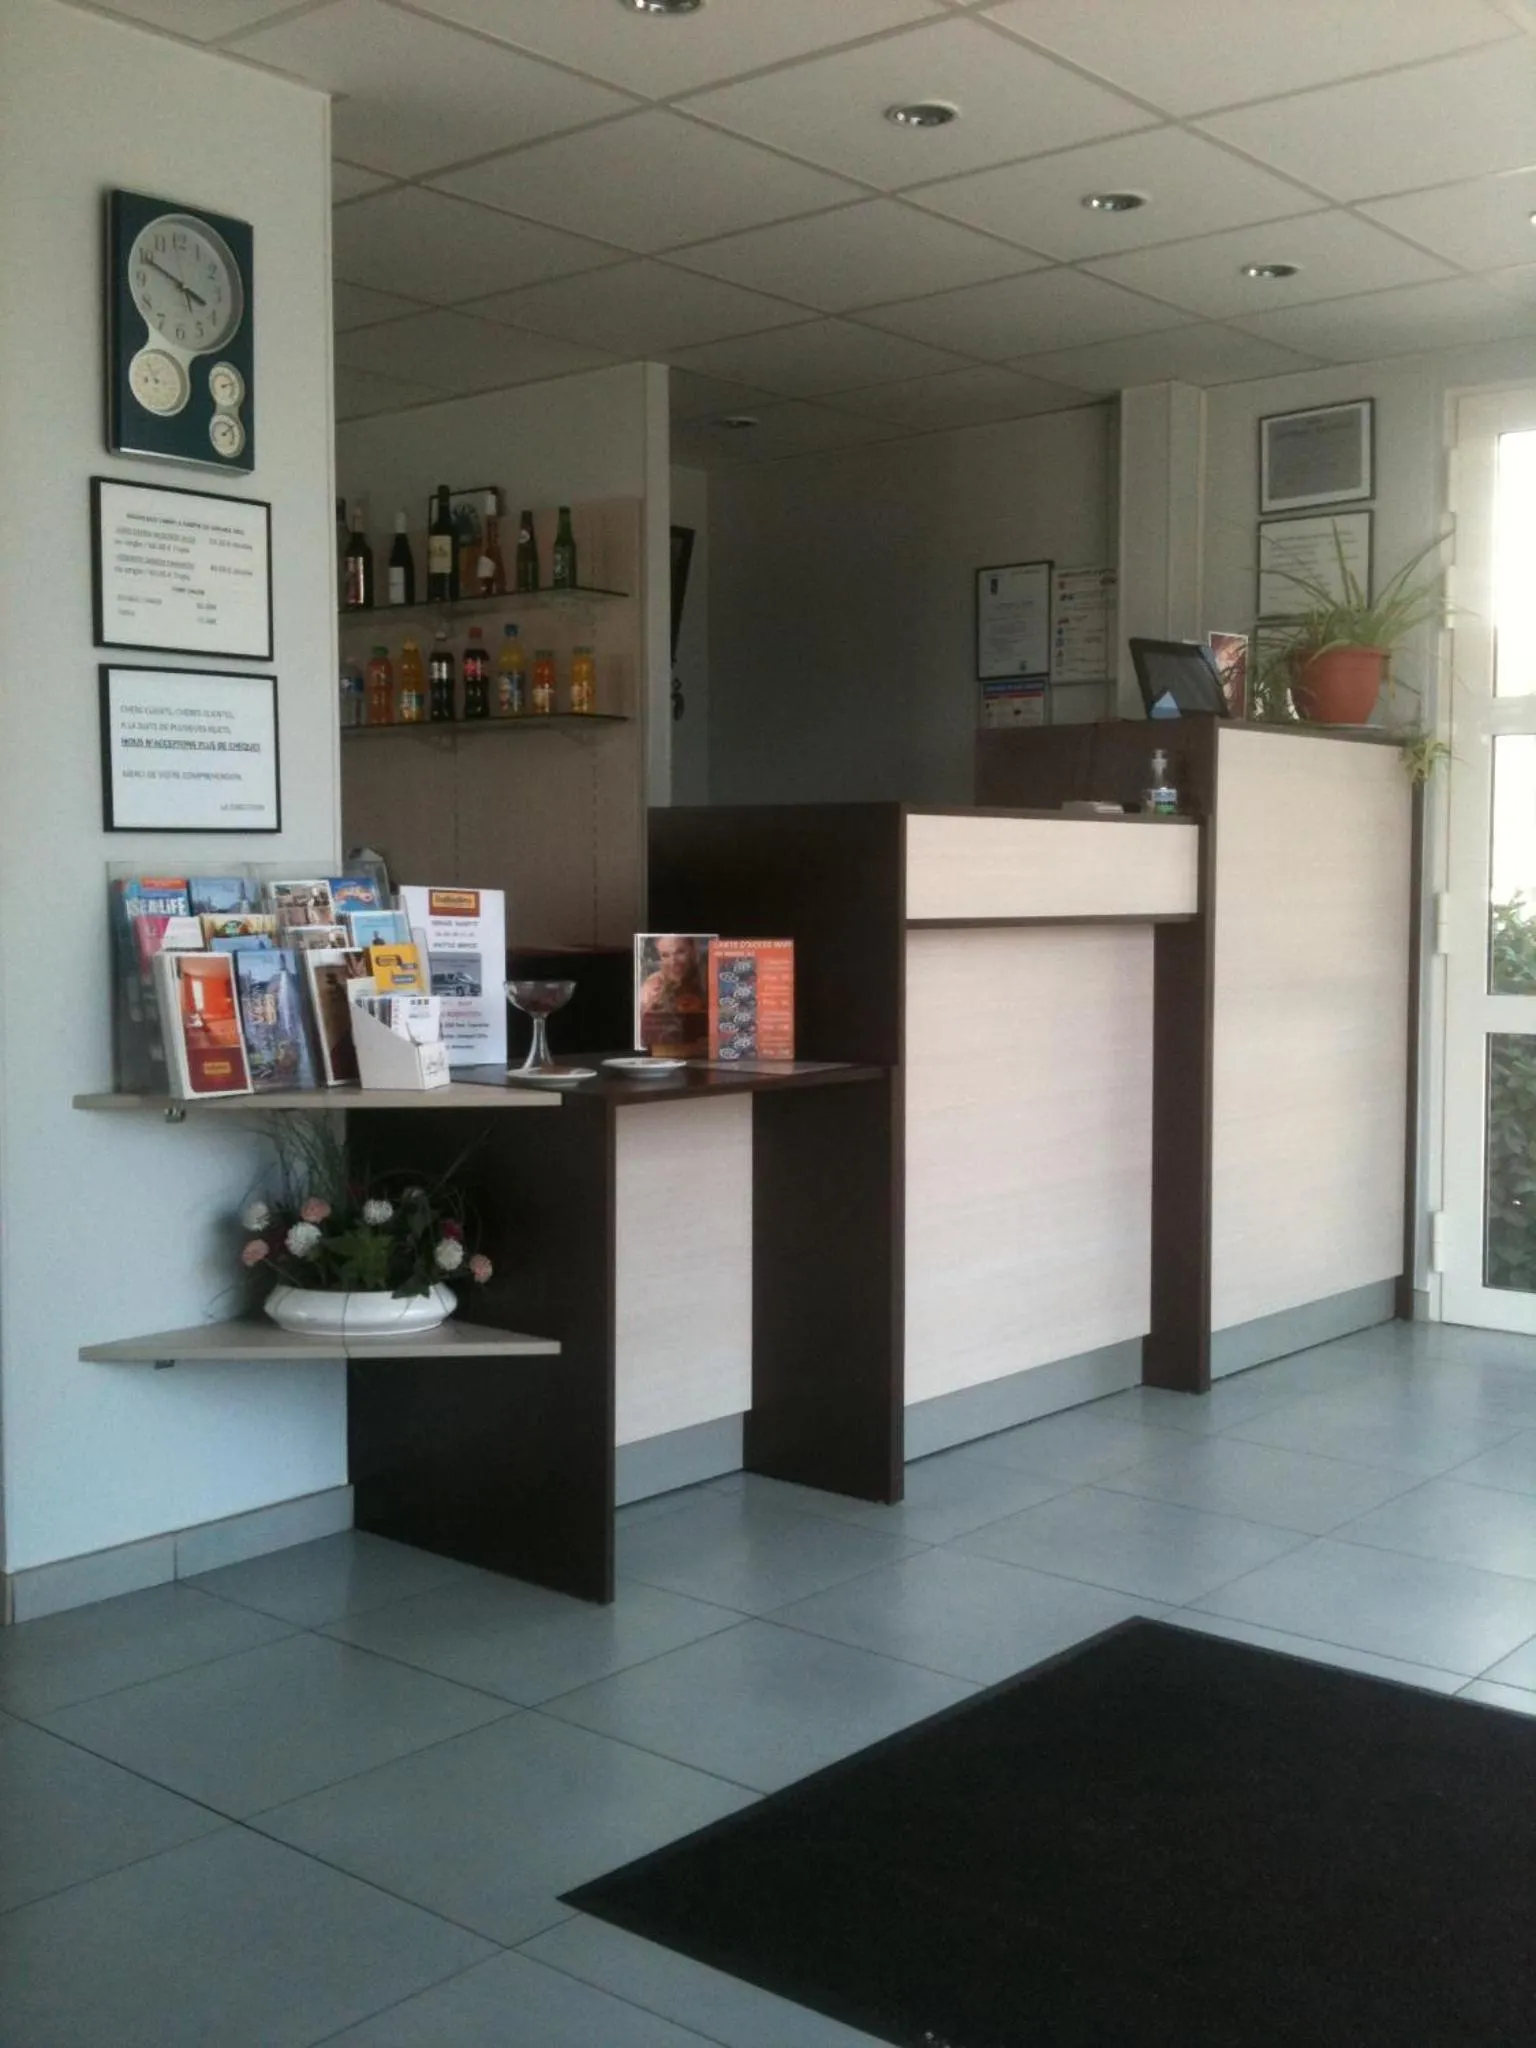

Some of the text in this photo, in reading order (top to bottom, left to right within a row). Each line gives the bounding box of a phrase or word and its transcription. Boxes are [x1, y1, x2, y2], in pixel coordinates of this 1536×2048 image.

[155, 233, 166, 253] 11
[172, 232, 187, 251] 12
[136, 270, 147, 288] 9
[208, 262, 218, 280] 2
[156, 312, 167, 330] 7
[195, 319, 205, 337] 5
[175, 322, 186, 340] 6
[121, 738, 144, 748] NOUS
[199, 741, 216, 751] PLUS
[217, 742, 228, 752] DE
